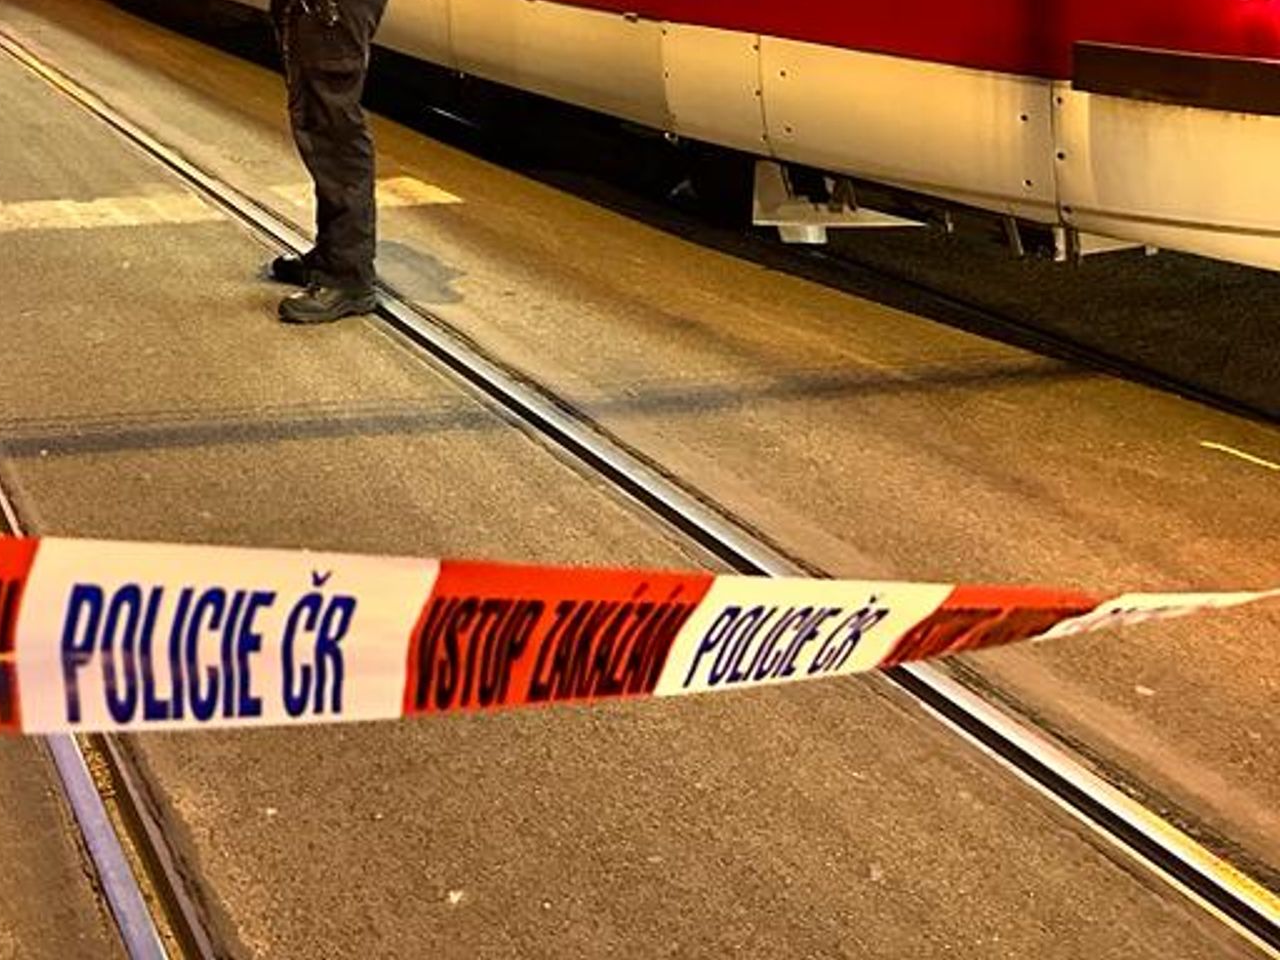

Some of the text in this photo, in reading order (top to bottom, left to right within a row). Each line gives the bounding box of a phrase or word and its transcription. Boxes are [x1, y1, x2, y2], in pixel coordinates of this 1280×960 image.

[61, 583, 277, 724] POLICIE
[281, 570, 357, 718] ČR
[415, 597, 545, 711] VSTUP
[526, 582, 697, 704] ZAKÁZÁN
[682, 605, 843, 688] POLICIE
[806, 594, 890, 674] ČR
